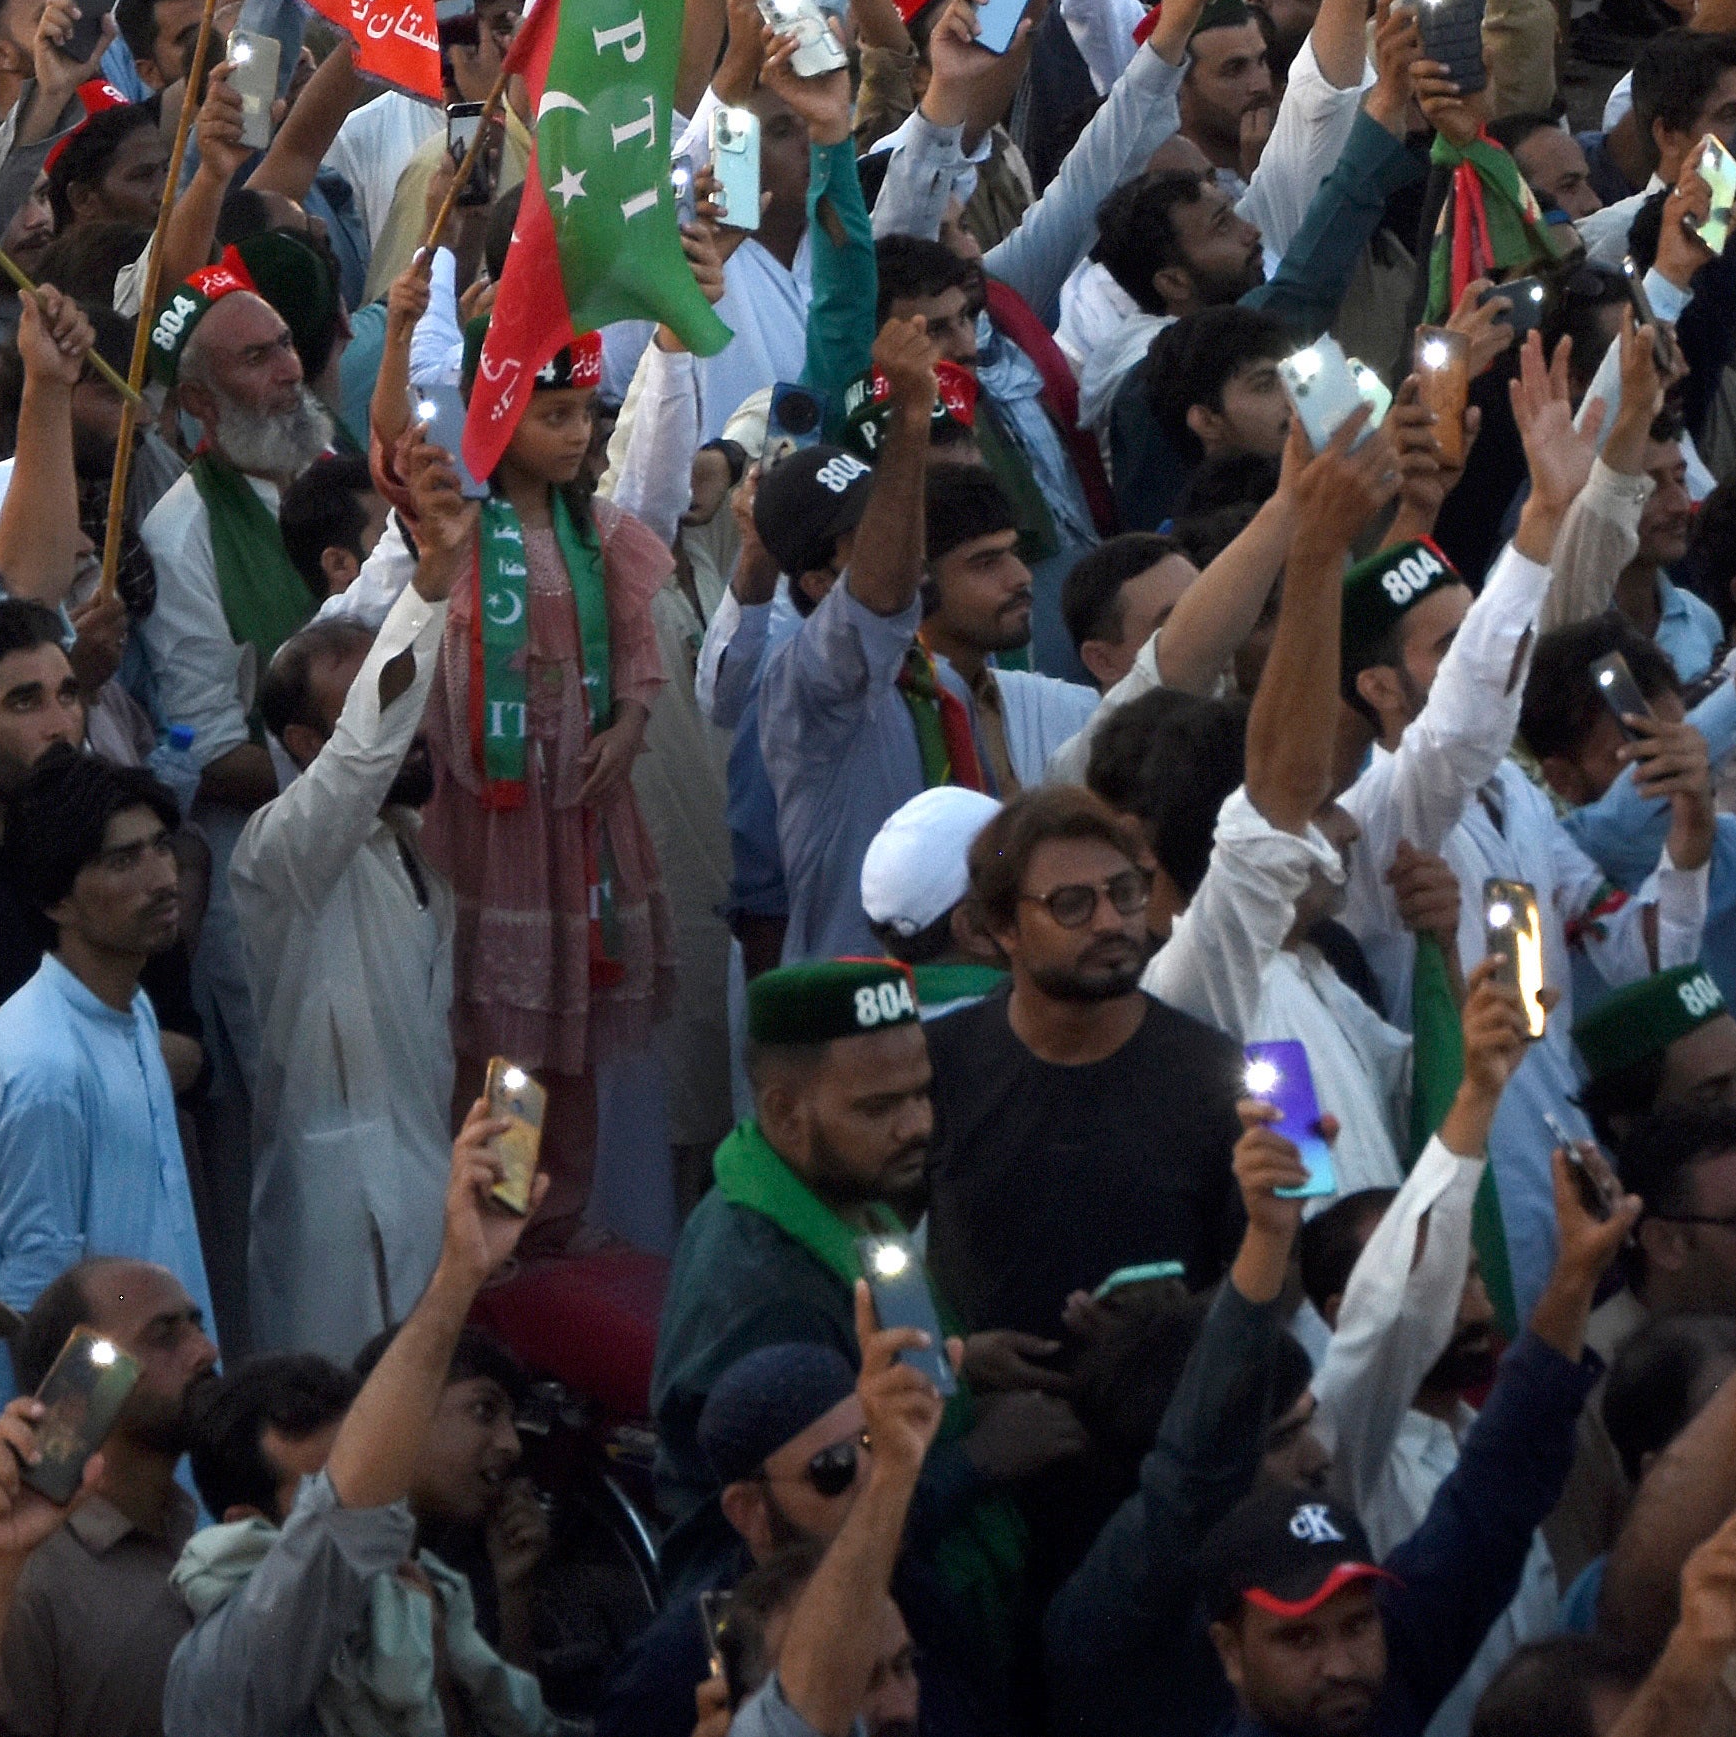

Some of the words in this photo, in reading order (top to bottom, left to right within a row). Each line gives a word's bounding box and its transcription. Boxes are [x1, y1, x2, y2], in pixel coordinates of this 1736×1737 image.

[594, 8, 661, 223] PTI
[152, 294, 198, 351] 804
[815, 453, 872, 493] 804
[1381, 547, 1444, 605] 804
[854, 977, 914, 1026] 804
